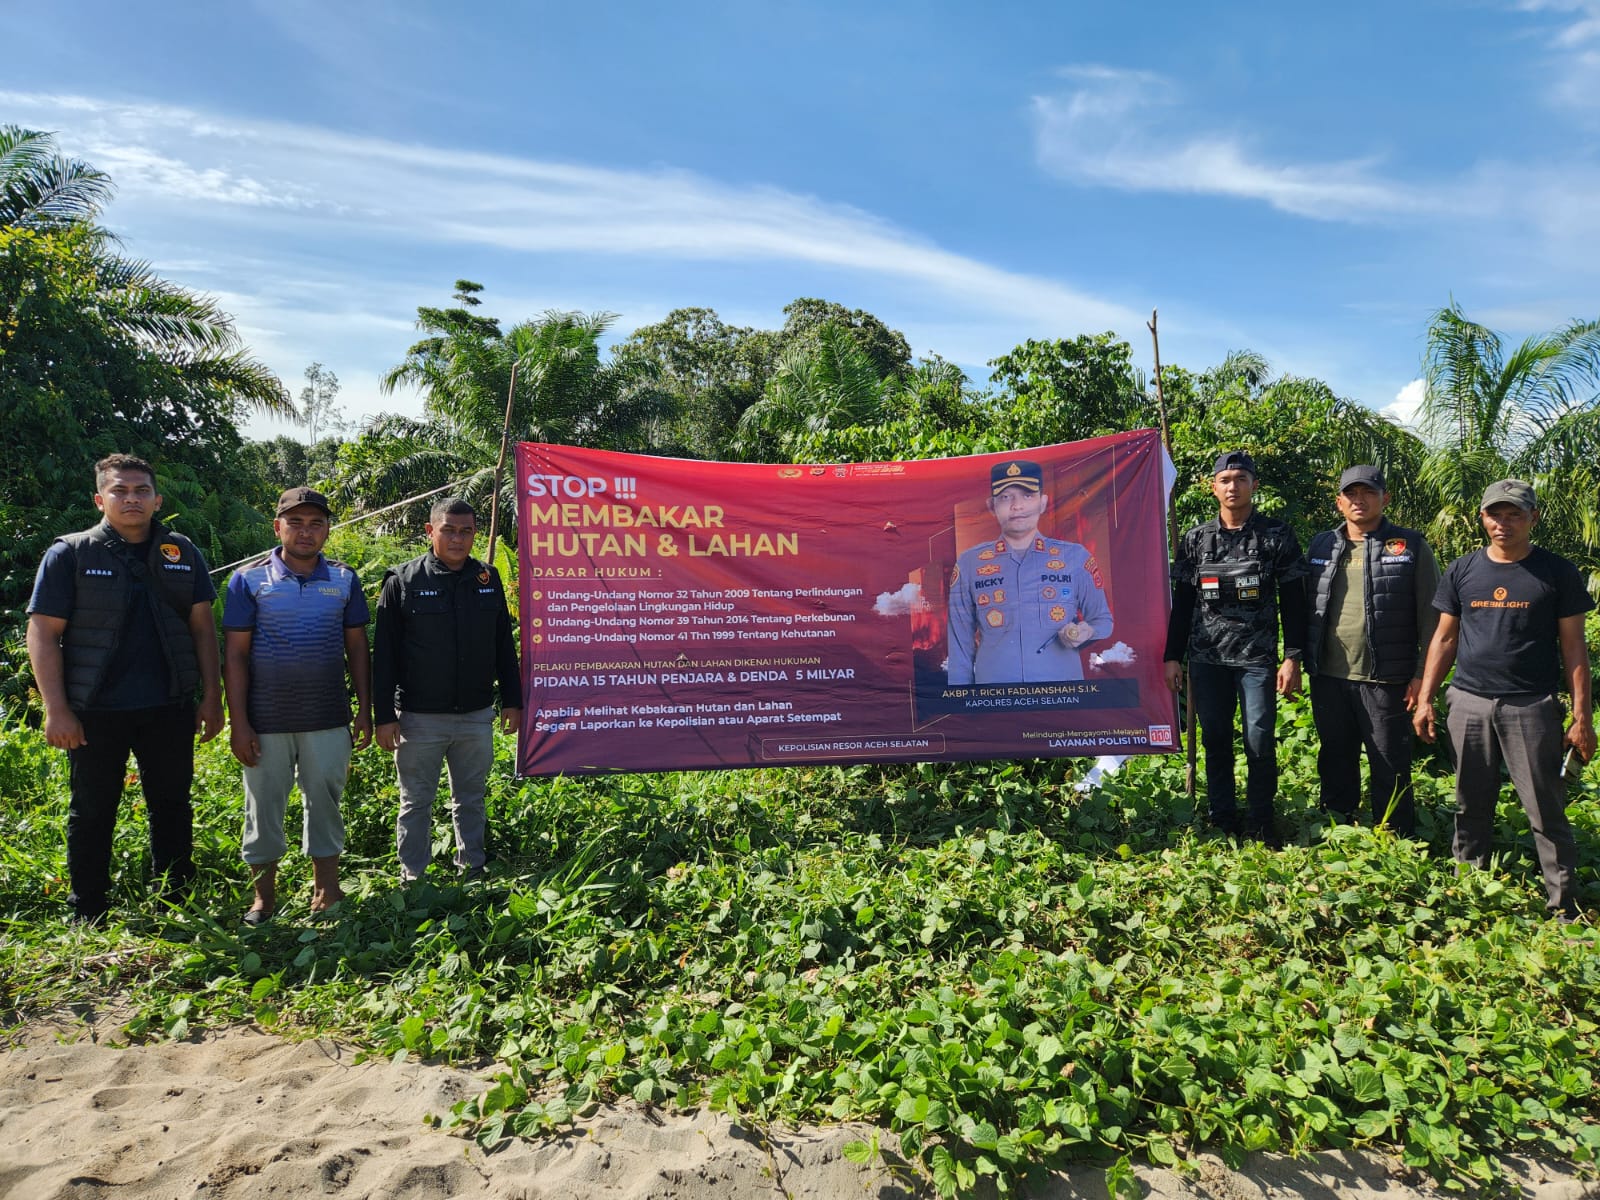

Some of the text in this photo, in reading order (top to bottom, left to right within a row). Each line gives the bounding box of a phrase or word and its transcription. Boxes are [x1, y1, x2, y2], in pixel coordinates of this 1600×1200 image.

[528, 474, 637, 500] STOP !!!
[531, 503, 724, 528] MEMBAKAR
[532, 532, 798, 557] HUTAN & LAHAN
[533, 567, 662, 577] DASAR HUKUM :
[1041, 574, 1072, 583] POLRI
[975, 577, 1004, 589] RICKY
[1237, 578, 1258, 586] POLISI
[548, 587, 862, 601] Undang-Undang Nomor 32 Tahun 2009 Tentang Perlindungan
[548, 602, 734, 613] dan Pengelolaan Lingkungan Hidup
[548, 614, 855, 628] Undang-Undang Nomor 39 Tahun 2014 Tentang Perkebunan
[548, 629, 836, 644] Undang-Undang Nomor 41 Thn 1999 Tentang Kehutanan
[534, 657, 821, 671] PELAKU PEMBAKARAN HUTAN DAN LAHAN DIKENAI HUKUMAN
[534, 668, 854, 688] PIDANA 15 TAHUN PENJARA & DENDA 5 MILYAR
[942, 690, 968, 698] AKBP
[970, 689, 978, 697] T.
[980, 688, 1005, 696] RICKI
[1008, 686, 1075, 695] FADLIANSHAH
[965, 696, 1079, 707] KAPOLRES ACEH SELATAN
[536, 701, 792, 719] Apabila Melihat Kebakaran Hutan dan Lahan
[535, 712, 841, 733] Segera Laporkan ke Kepolisian atau Aparat Setempat
[1049, 736, 1147, 747] LAYANAN POLISI 110
[1151, 730, 1170, 741] 110
[778, 743, 831, 752] KEPOLISIAN
[890, 739, 929, 748] SELATAN
